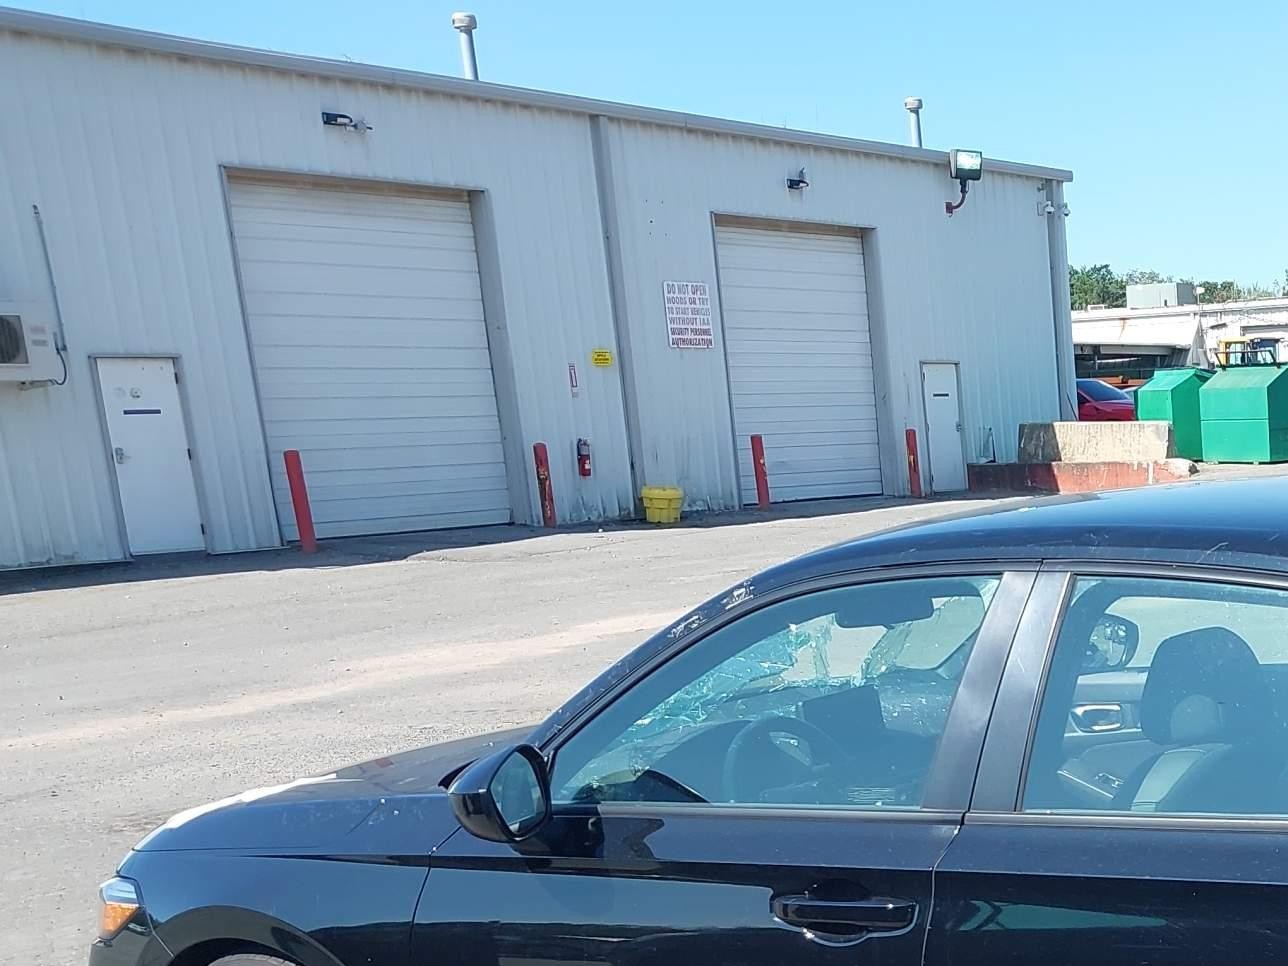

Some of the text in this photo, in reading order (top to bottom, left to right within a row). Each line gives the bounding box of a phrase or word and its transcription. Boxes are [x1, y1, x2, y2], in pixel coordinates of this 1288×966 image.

[666, 283, 707, 296] DO NOT OPEN
[666, 296, 709, 305] HOODS OR TRY
[667, 306, 711, 316] TO START VEHICLES
[669, 316, 697, 325] WITHOUT
[670, 327, 712, 336] SECURITY PERSONNEL
[672, 337, 713, 346] AUTHORIZATION
